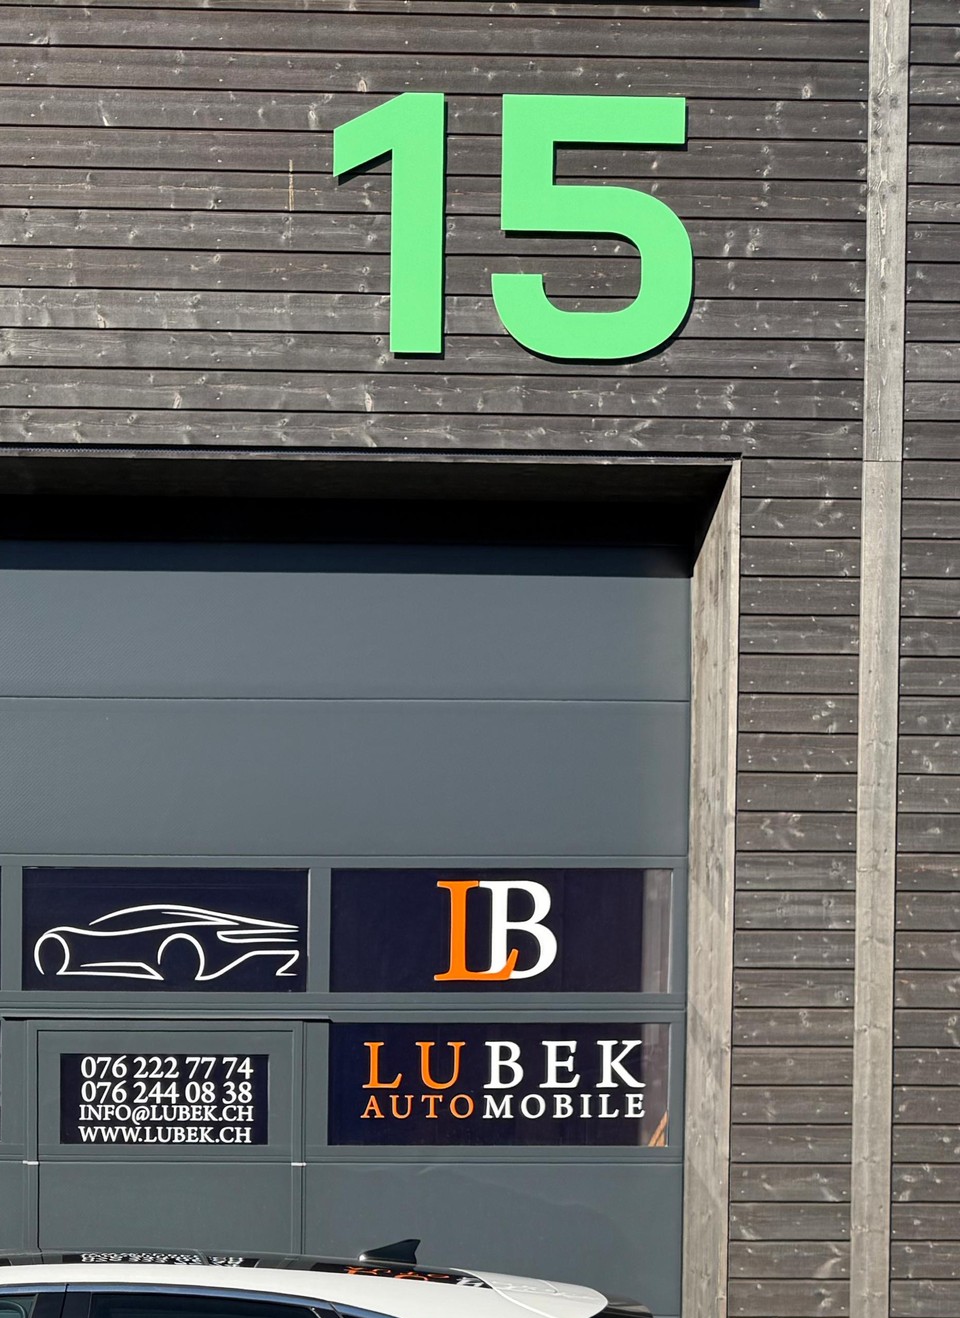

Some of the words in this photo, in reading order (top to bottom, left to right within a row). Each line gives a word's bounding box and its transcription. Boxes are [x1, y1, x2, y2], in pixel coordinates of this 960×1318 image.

[333, 92, 694, 360] 15
[433, 880, 558, 982] LB
[80, 1055, 128, 1079] 076
[132, 1056, 180, 1079] 222
[185, 1056, 217, 1079] 77
[222, 1056, 255, 1080] 74
[362, 1040, 645, 1090] LUBEK
[80, 1080, 128, 1104] 076
[132, 1081, 180, 1104] 244
[184, 1081, 216, 1104] 08
[221, 1081, 253, 1105] 38
[78, 1104, 255, 1126] INFO@LUBEK.CH
[78, 1126, 252, 1144] WWW.LUBEK.CH
